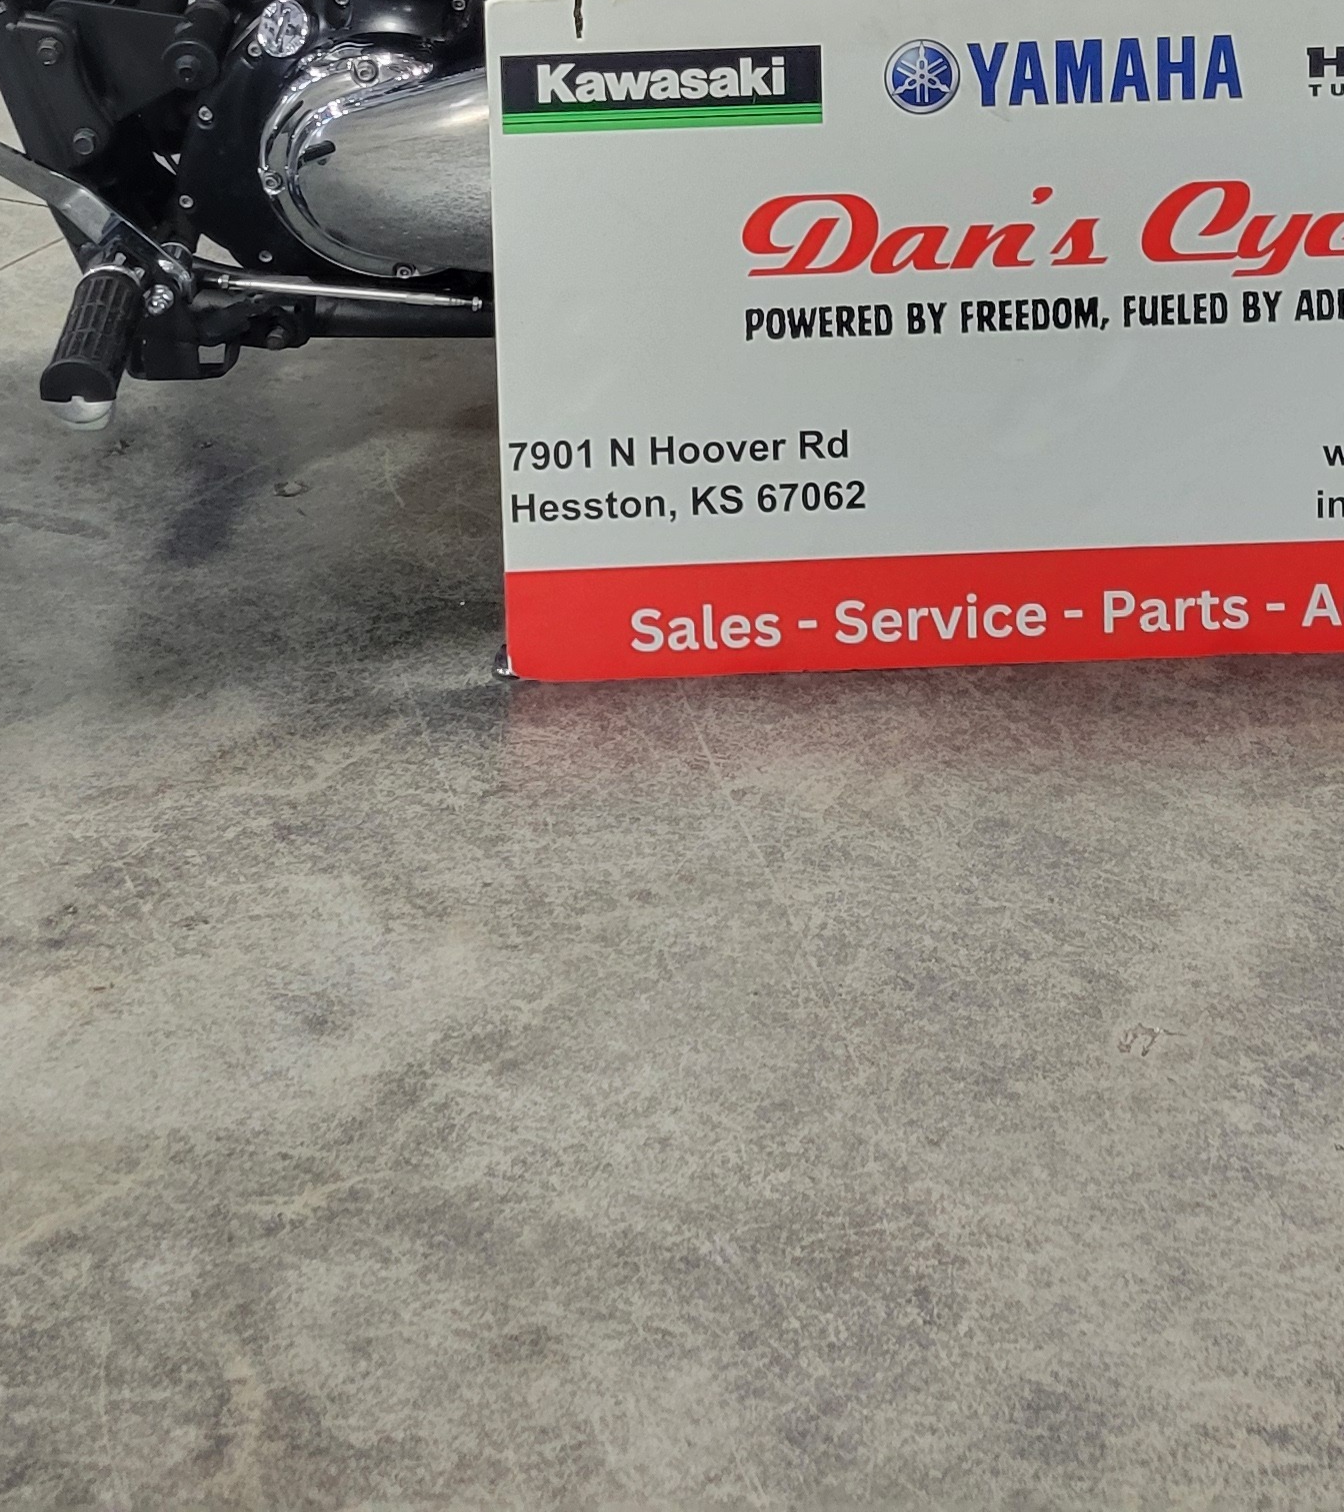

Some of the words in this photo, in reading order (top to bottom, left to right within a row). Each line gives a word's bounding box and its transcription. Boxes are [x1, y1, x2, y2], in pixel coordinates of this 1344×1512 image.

[536, 56, 786, 104] Kawasaki
[967, 34, 1243, 108] YAMAHA
[741, 186, 1108, 278] Dan's
[744, 303, 893, 342] POWERED
[906, 302, 947, 337] BY
[960, 296, 1111, 334] FREEDOM,
[1122, 293, 1229, 328] FUELED
[1242, 290, 1283, 324] BY
[508, 439, 593, 472] 7901
[609, 438, 636, 468] N
[649, 433, 787, 467] Hoover
[798, 429, 850, 461] Rd
[510, 488, 678, 524] Hesston,
[690, 485, 745, 518] KS
[756, 480, 867, 514] 67062
[630, 604, 782, 653] Sales
[834, 593, 1047, 644] Service
[1102, 588, 1250, 634] Parts
